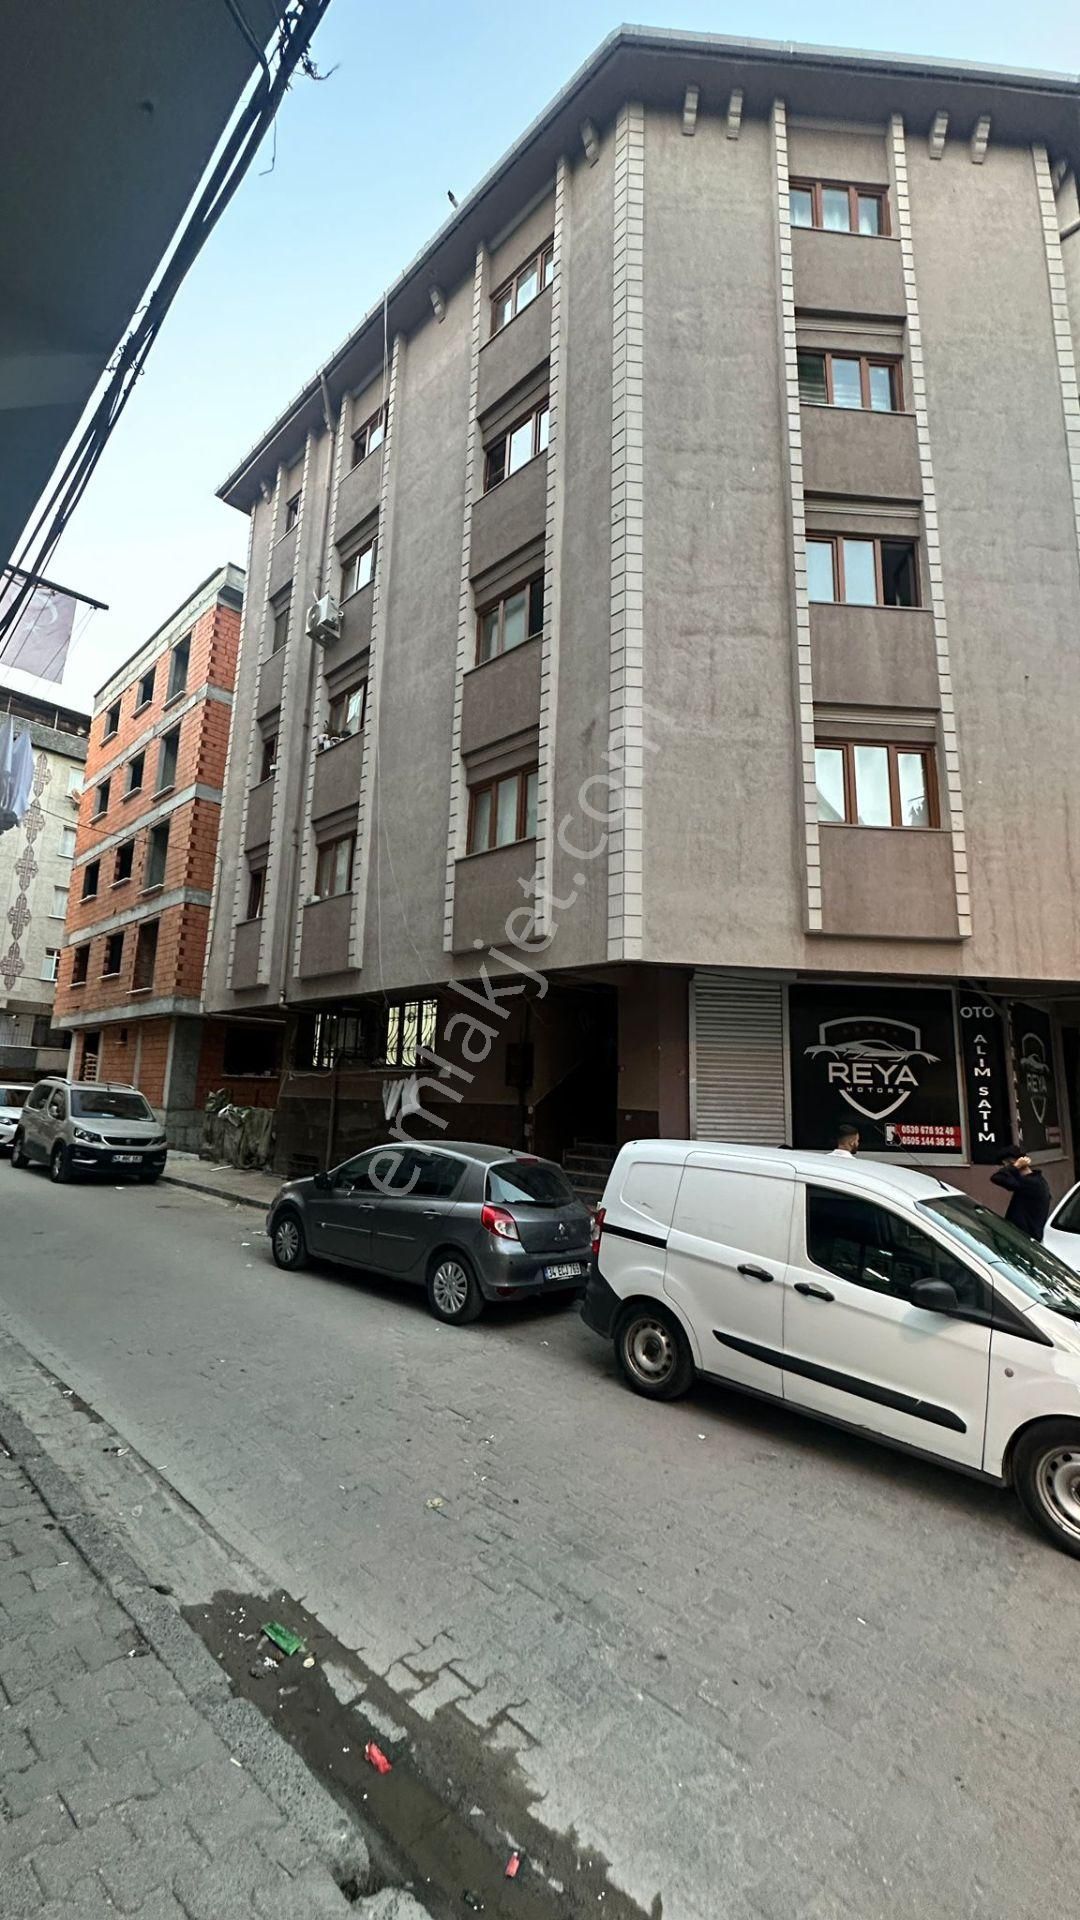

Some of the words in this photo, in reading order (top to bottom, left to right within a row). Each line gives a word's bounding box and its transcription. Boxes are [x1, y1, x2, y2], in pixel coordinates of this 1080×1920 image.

[960, 1006, 994, 1018] OTO
[973, 1034, 991, 1077] ALIM
[828, 1062, 919, 1087] REYA
[846, 1086, 905, 1095] MOTORS
[978, 1086, 996, 1143] SATIM
